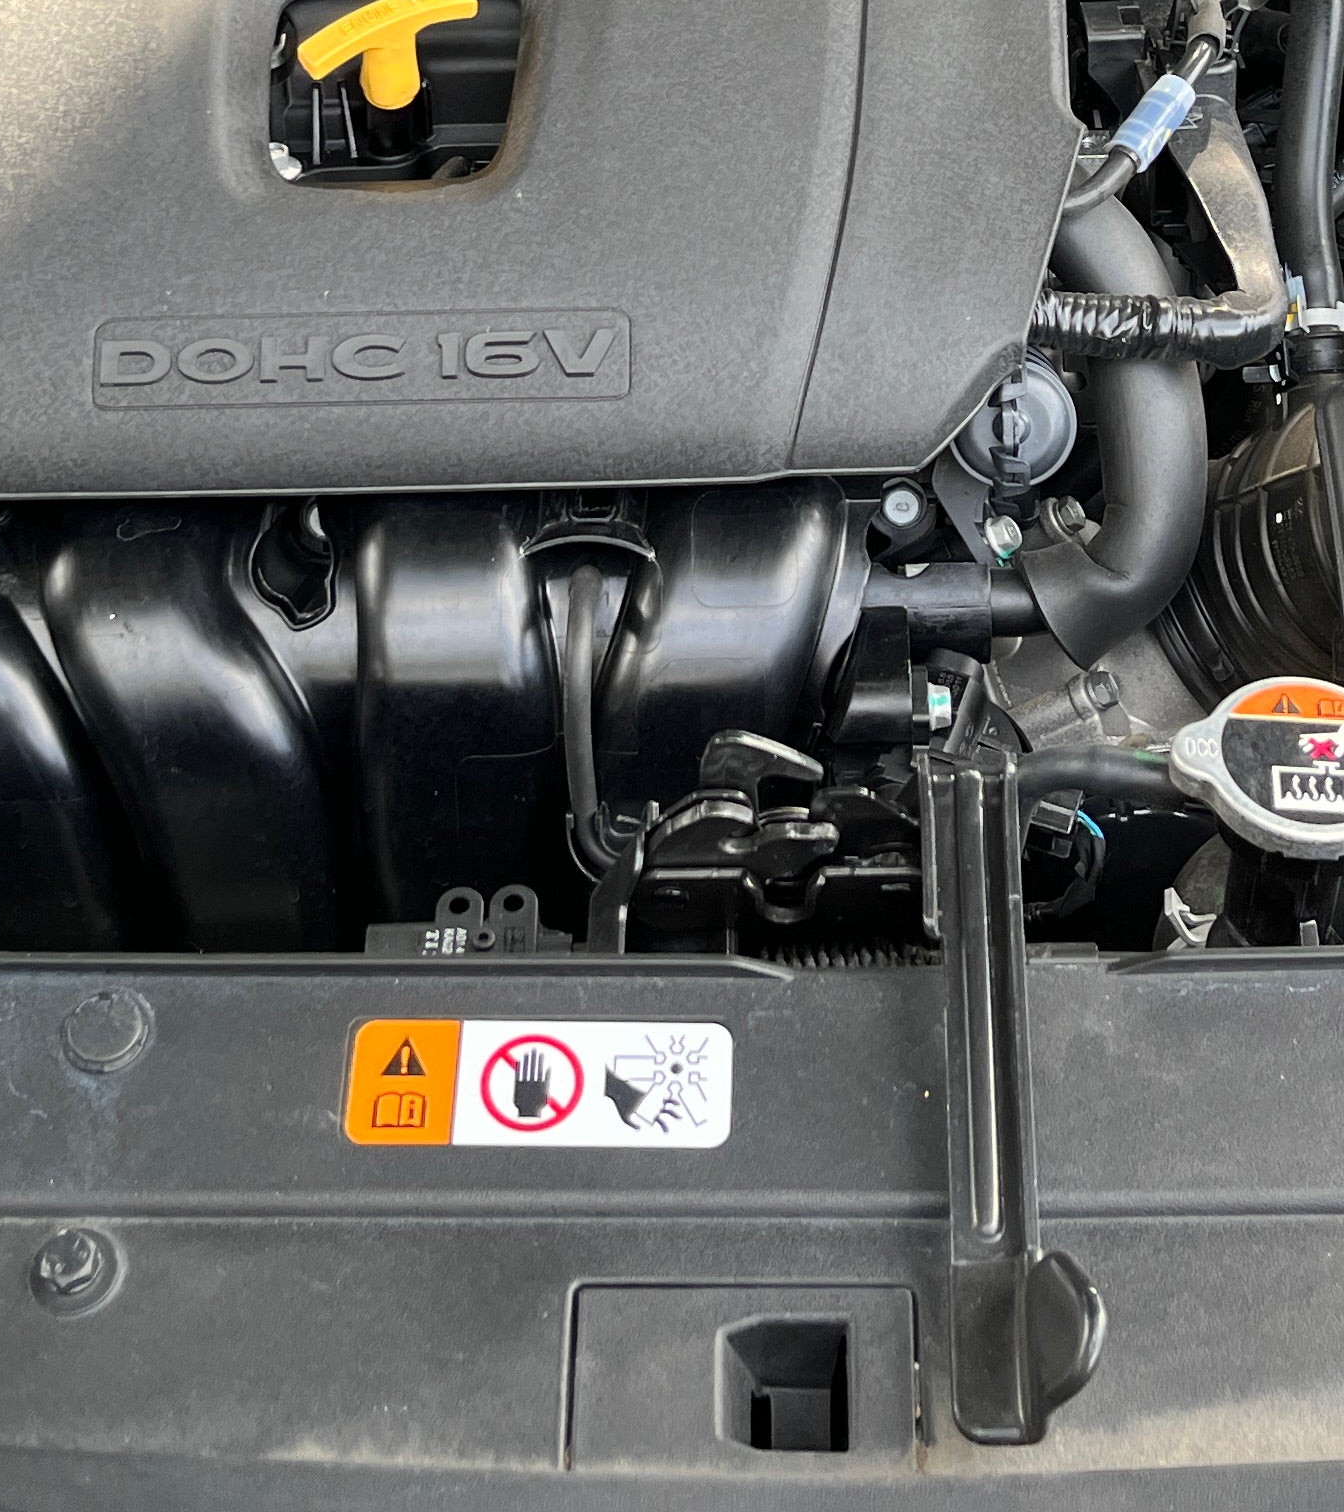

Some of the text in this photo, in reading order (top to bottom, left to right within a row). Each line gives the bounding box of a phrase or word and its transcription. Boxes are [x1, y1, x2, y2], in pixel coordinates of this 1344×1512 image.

[342, 3, 399, 36] ENGINE
[99, 326, 621, 387] DOHC 16V
[1185, 737, 1219, 758] DCC
